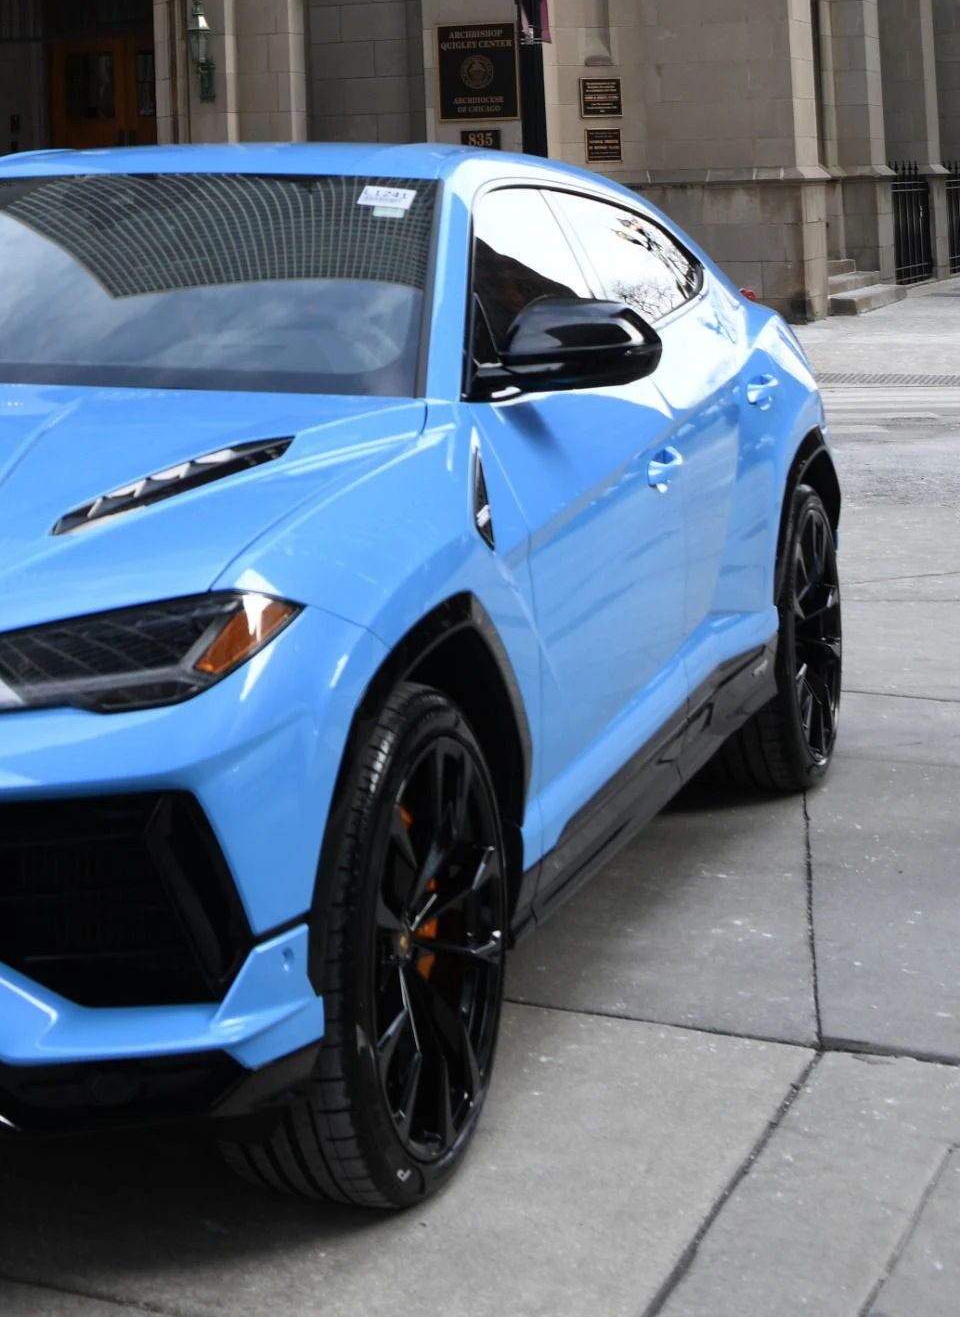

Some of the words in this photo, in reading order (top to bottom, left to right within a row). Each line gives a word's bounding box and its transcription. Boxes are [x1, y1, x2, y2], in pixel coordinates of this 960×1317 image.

[448, 29, 503, 39] ARCHBISHOP
[440, 41, 478, 51] QUIGLEY
[478, 39, 513, 48] CENTER
[453, 95, 505, 104] ARCHDIOCESE
[457, 105, 466, 113] OF
[468, 105, 501, 113] CHICAGO
[468, 132, 493, 147] 835
